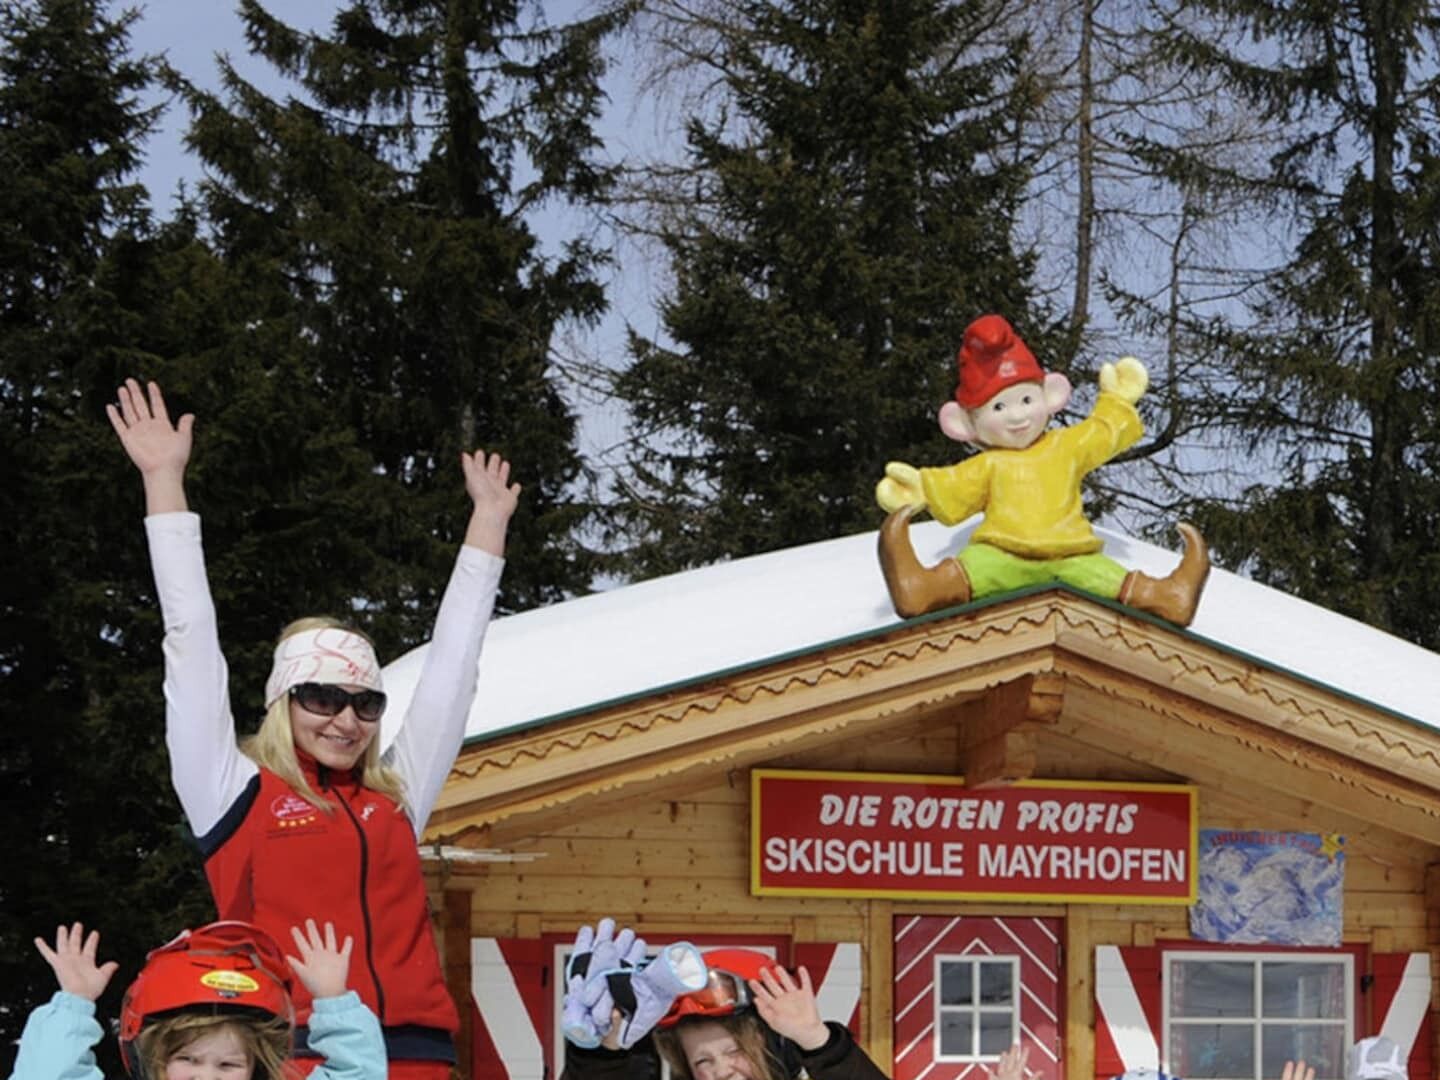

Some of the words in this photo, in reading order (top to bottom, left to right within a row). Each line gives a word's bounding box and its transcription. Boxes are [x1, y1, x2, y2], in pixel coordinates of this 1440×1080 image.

[819, 793, 882, 828] DIE
[890, 795, 1005, 831] ROTEN
[1016, 800, 1139, 834] PROFIS
[764, 836, 964, 877] SKISCHULE
[978, 843, 1186, 882] MAYRHOFEN
